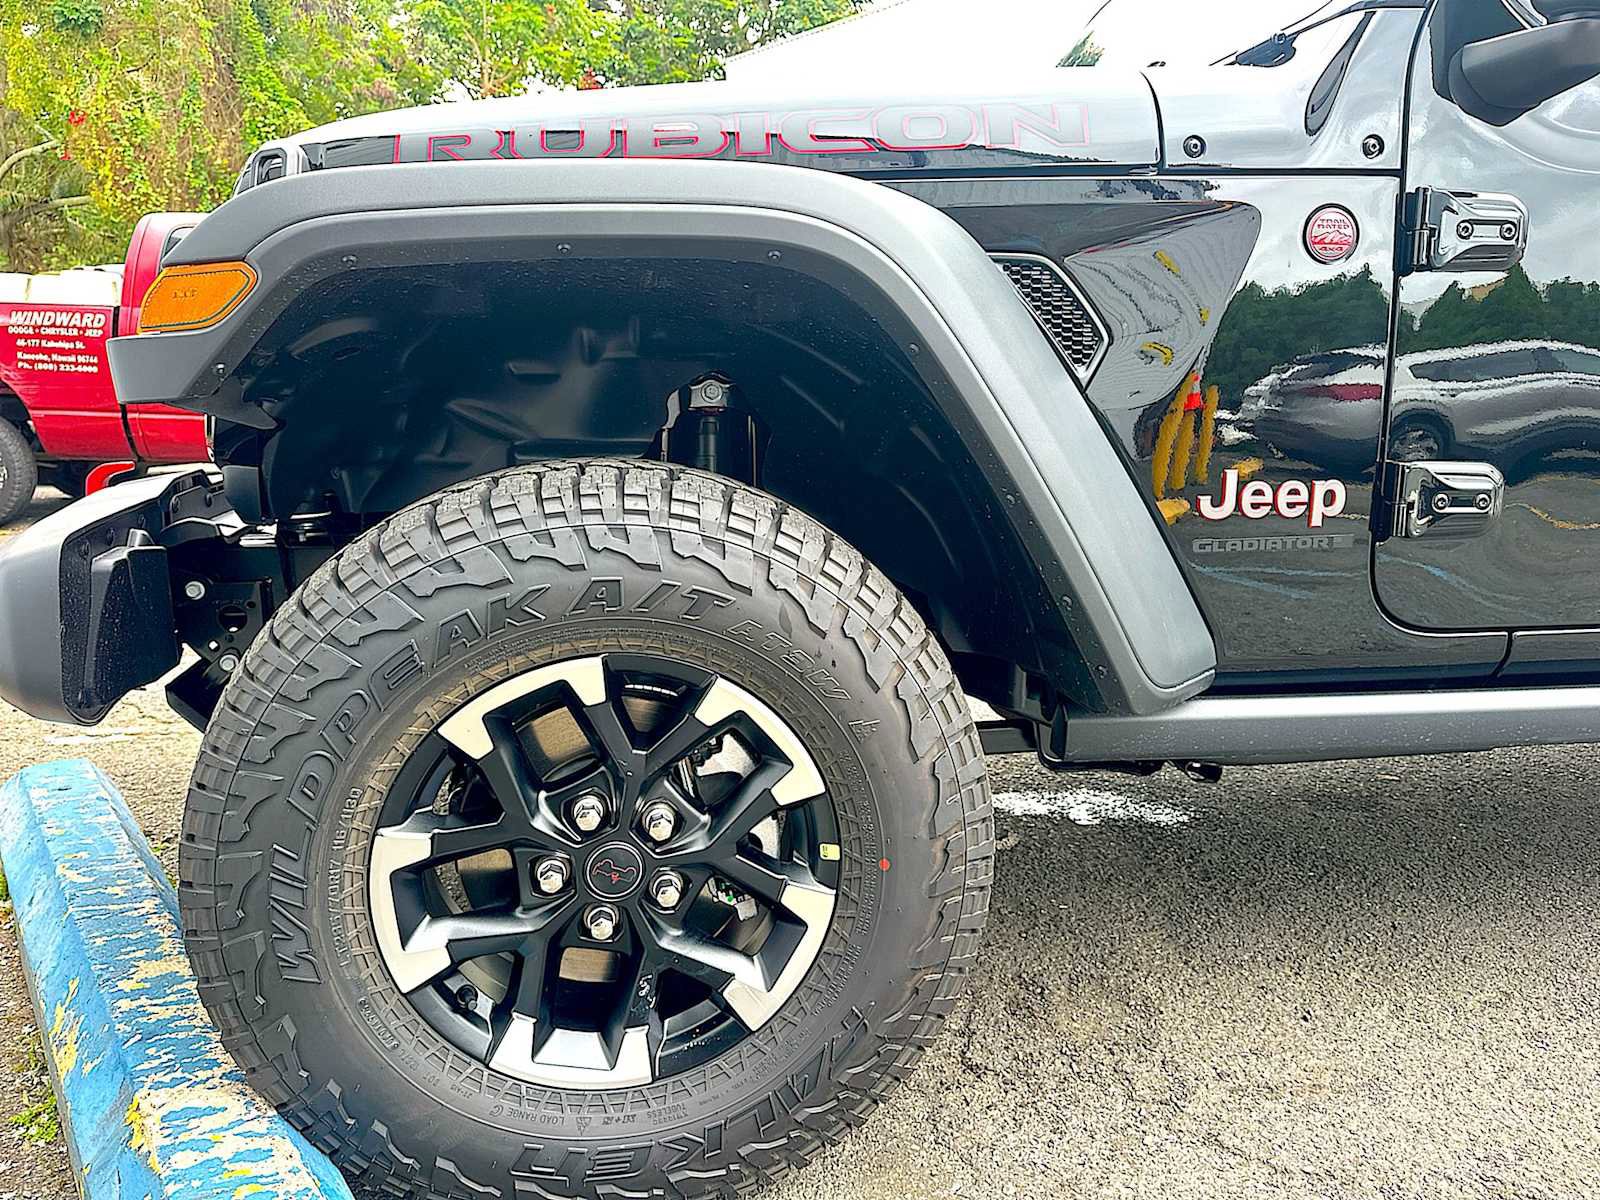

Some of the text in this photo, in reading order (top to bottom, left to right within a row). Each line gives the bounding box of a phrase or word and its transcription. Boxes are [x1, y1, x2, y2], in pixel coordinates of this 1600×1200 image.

[391, 102, 1091, 164] RUBICON
[9, 311, 106, 328] WINDWARD
[8, 326, 104, 337] DODGE CHRYSLER JEEP
[1196, 468, 1347, 528] Jeep
[1192, 535, 1331, 553] GLADIATOR
[267, 583, 551, 984] WILDPEAK
[562, 576, 736, 621] A/T
[510, 1002, 875, 1187] FALKEN
[506, 1107, 539, 1122] RANGE
[540, 1113, 565, 1125] LOAD
